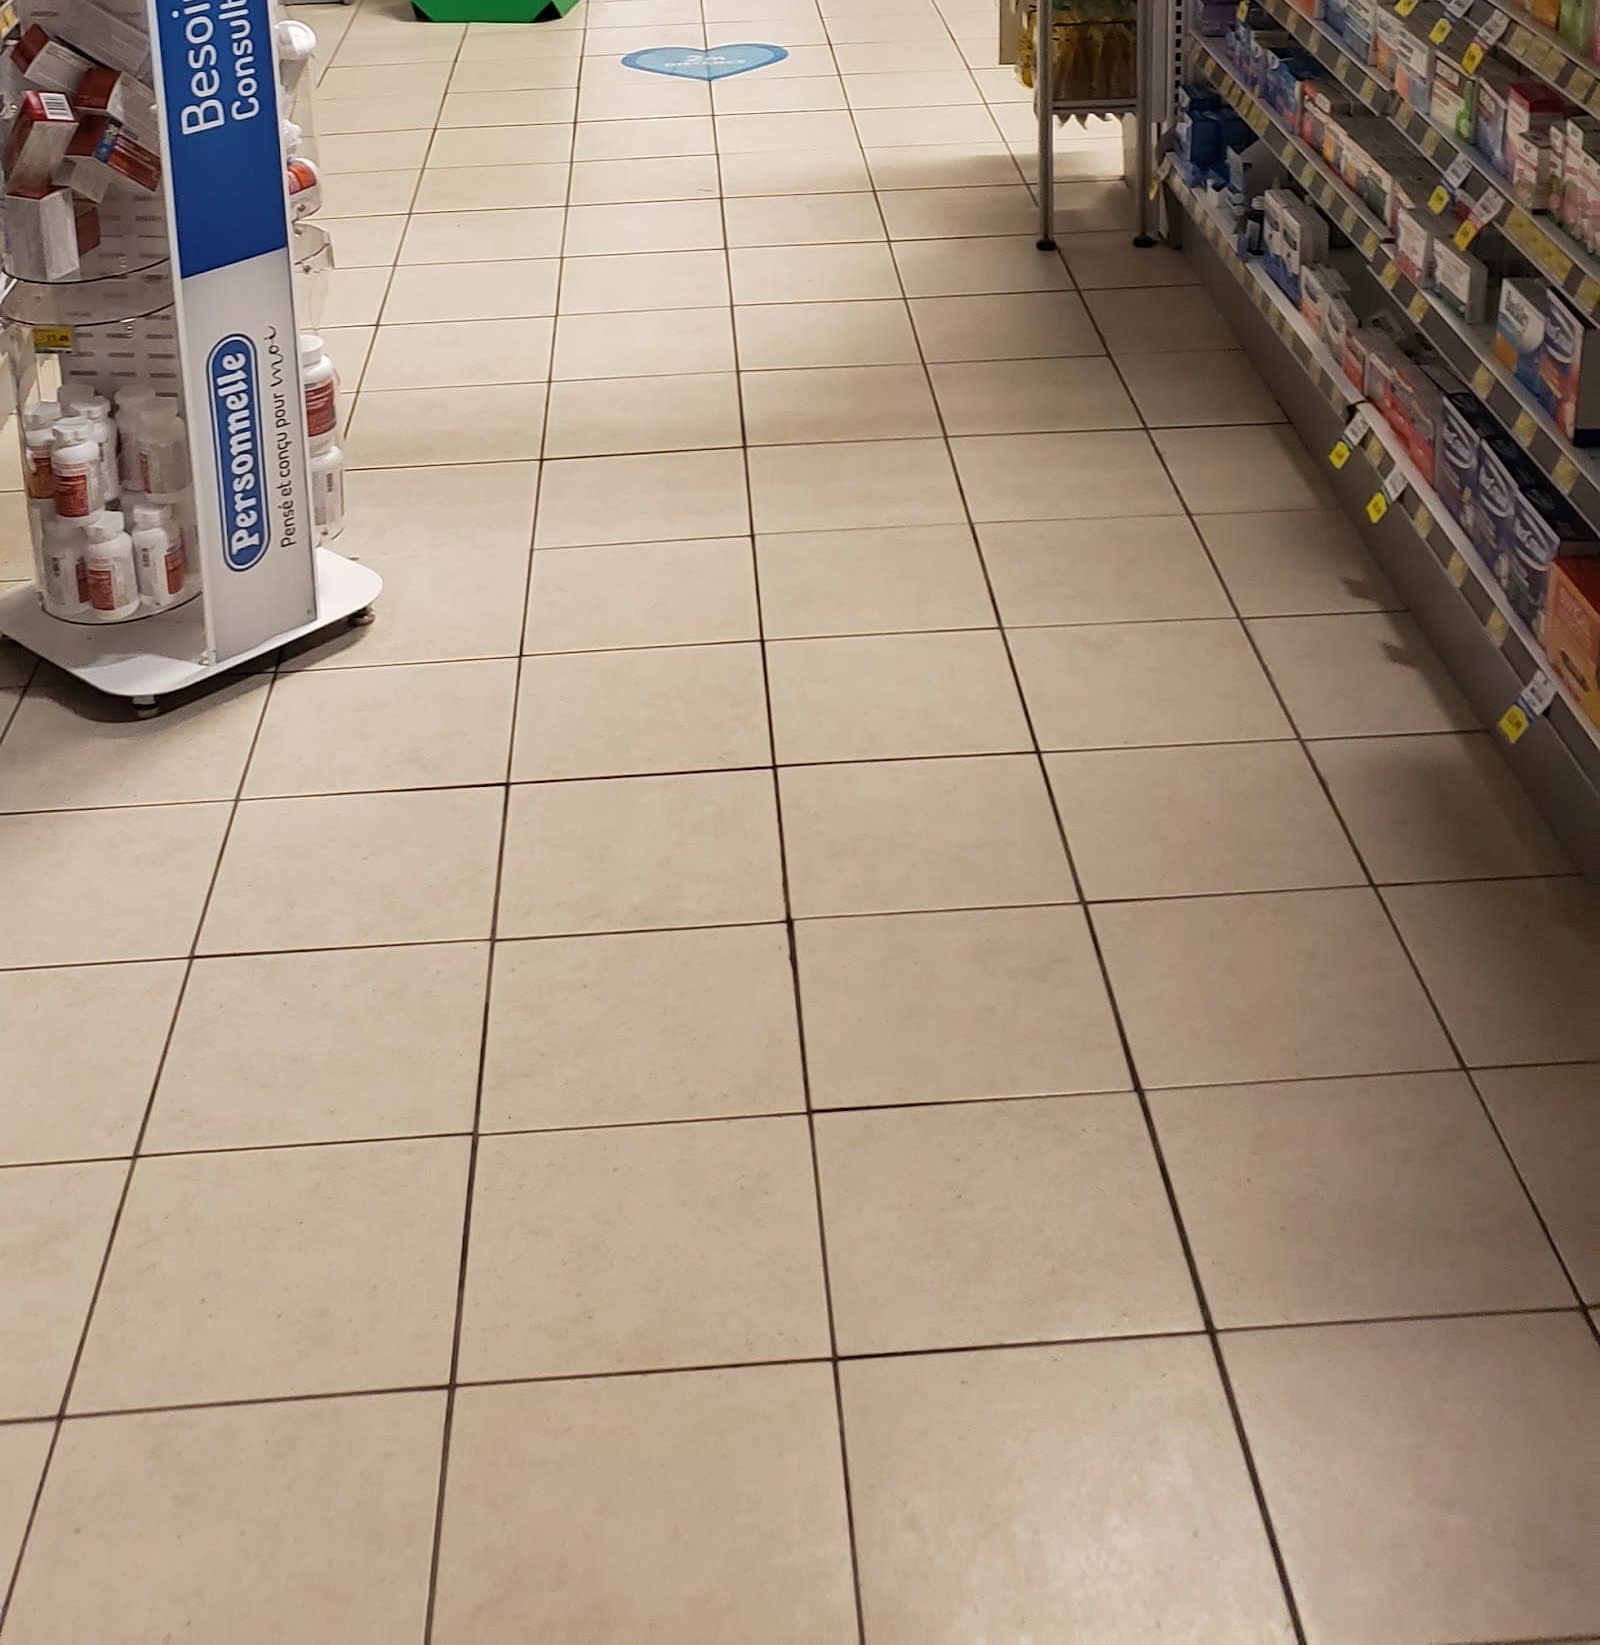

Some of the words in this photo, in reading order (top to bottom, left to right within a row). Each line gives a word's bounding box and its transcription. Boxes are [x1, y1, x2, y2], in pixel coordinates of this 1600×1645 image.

[263, 325, 285, 388] moi
[272, 393, 292, 429] pour
[216, 351, 261, 555] Personnelle
[276, 431, 293, 478] conçu
[276, 480, 293, 497] et
[276, 500, 297, 549] Pensé
